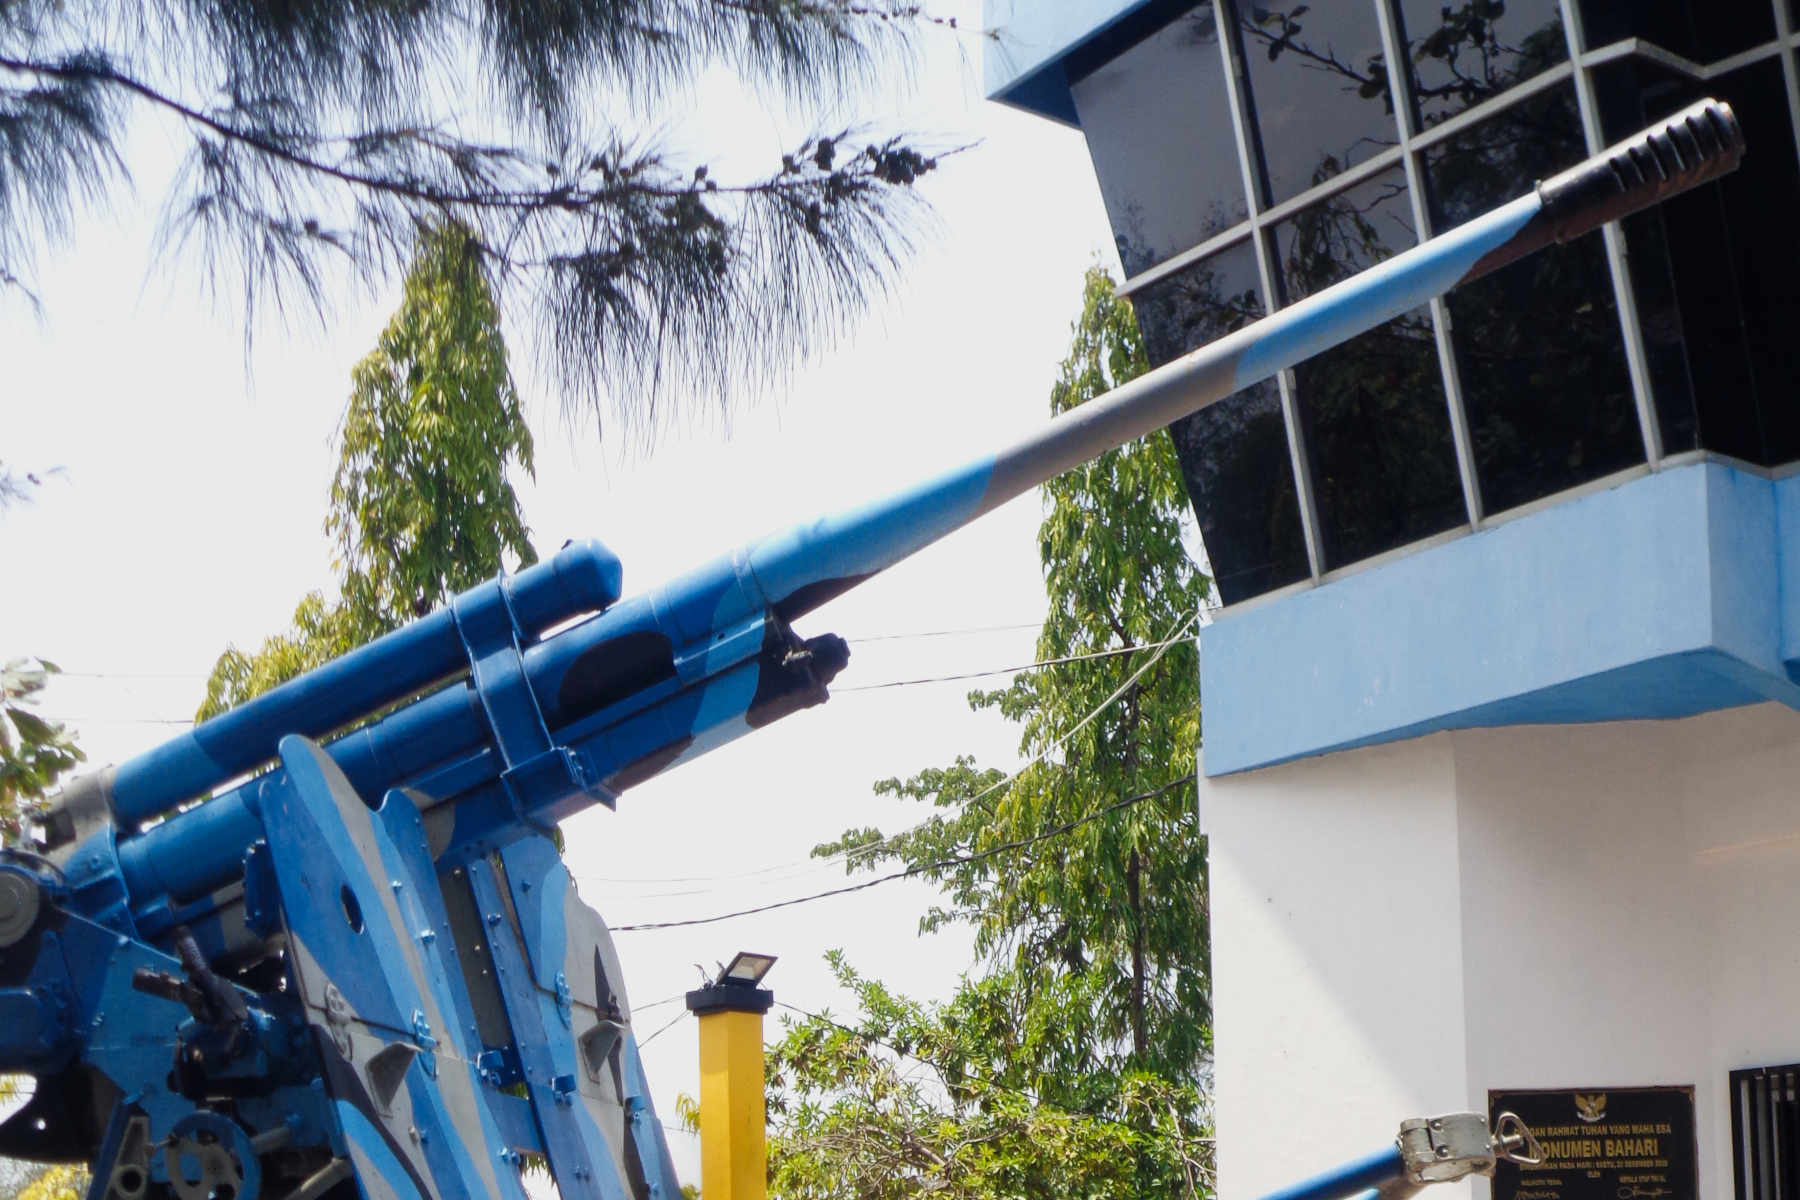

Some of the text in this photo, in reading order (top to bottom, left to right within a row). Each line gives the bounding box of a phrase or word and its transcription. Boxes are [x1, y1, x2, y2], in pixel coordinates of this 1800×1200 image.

[1514, 1126, 1546, 1138] DGAN
[1547, 1125, 1579, 1137] RAHMAT
[1581, 1125, 1608, 1136] TUHAN
[1609, 1124, 1630, 1136] YANG
[1656, 1123, 1672, 1135] ESA
[1529, 1138, 1659, 1159] MONUMEN BAHARI
